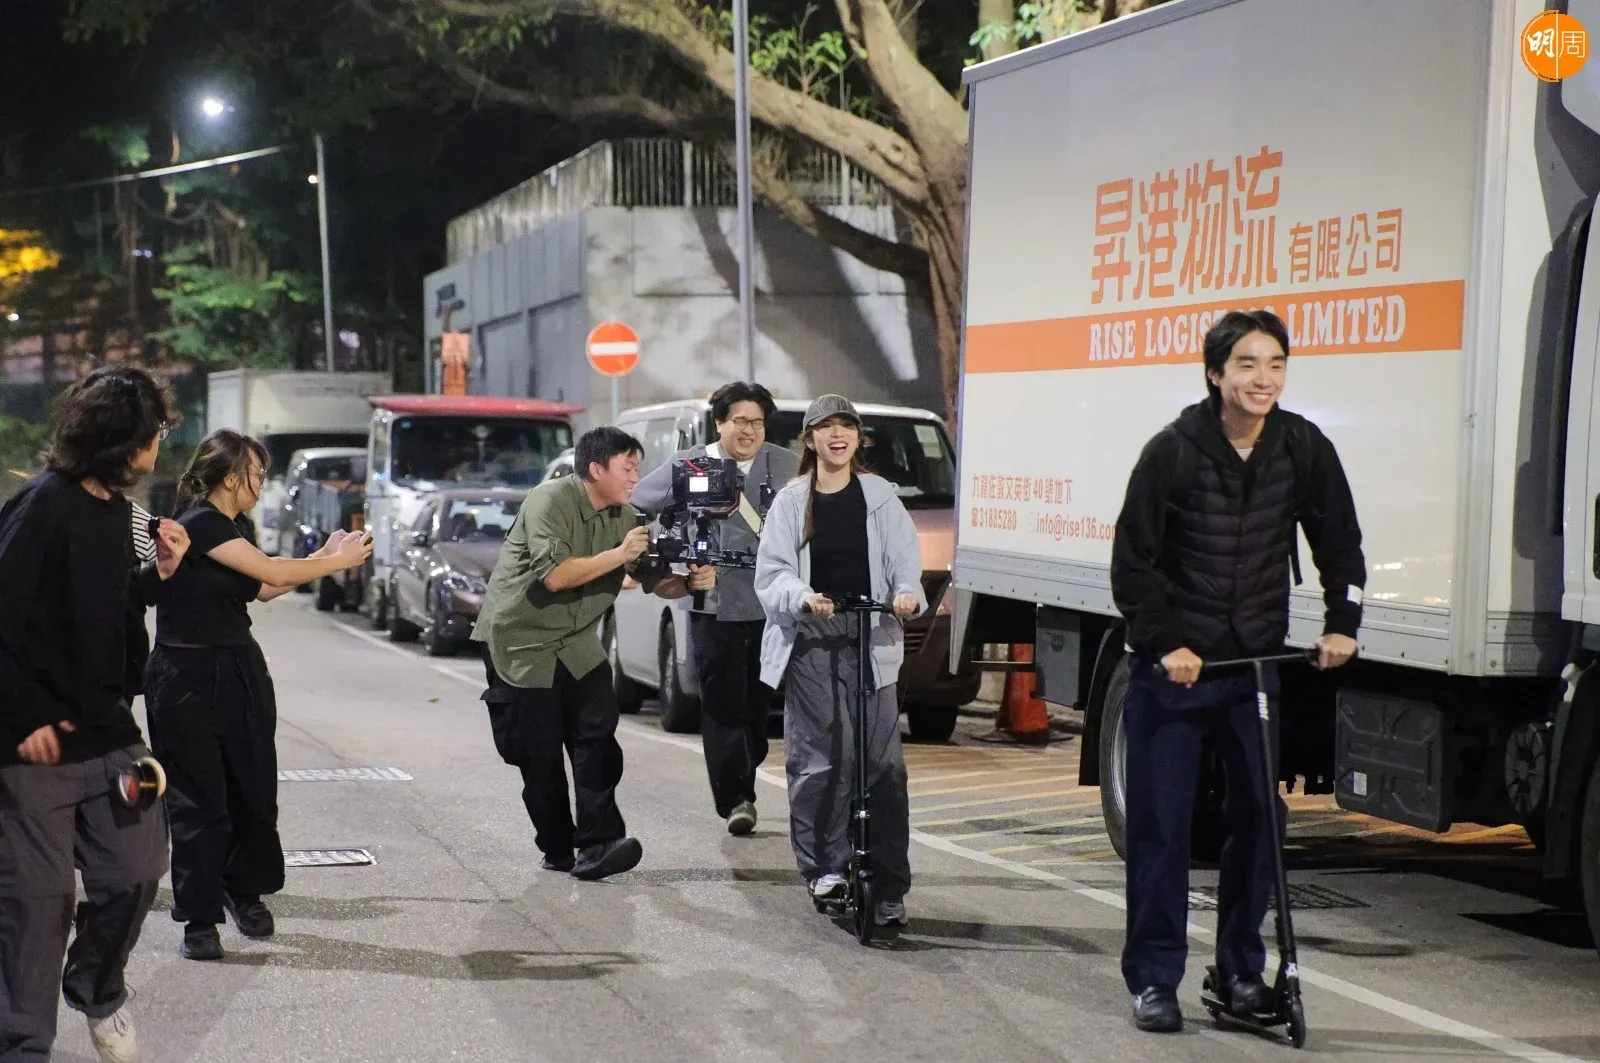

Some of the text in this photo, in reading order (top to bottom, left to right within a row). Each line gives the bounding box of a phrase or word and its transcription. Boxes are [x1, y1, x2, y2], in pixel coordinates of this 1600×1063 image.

[1090, 144, 1403, 305] 昇港物流 有限公司
[1089, 318, 1136, 361] RISE
[1286, 294, 1407, 347] LIMITED
[979, 507, 1017, 531] 31885280
